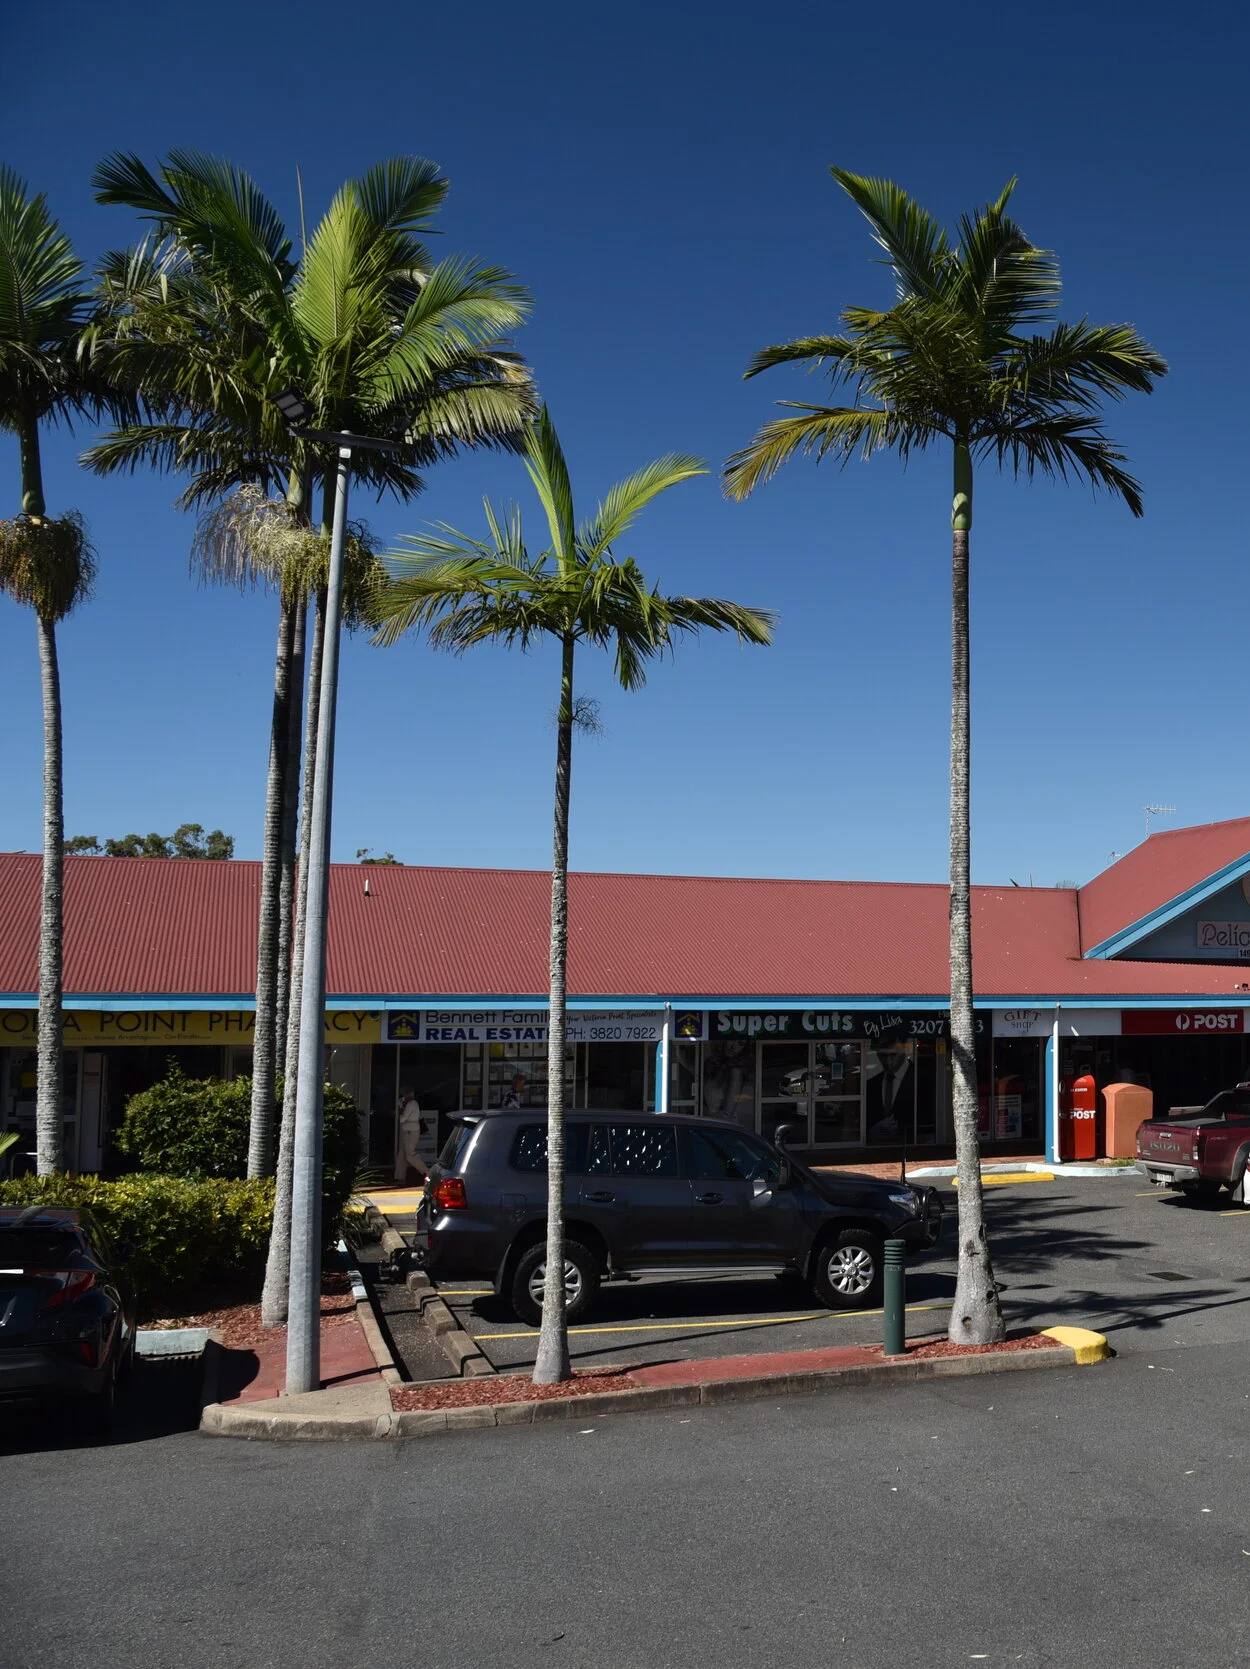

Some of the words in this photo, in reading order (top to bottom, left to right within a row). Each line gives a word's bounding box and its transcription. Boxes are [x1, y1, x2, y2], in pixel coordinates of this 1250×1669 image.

[100, 1011, 193, 1033] POINT
[426, 1010, 497, 1024] Bennett
[503, 1010, 551, 1024] Famil
[717, 1010, 789, 1036] Super
[801, 1010, 853, 1032] Cuts
[1004, 1009, 1042, 1023] GIFT
[1193, 1014, 1239, 1029] POST
[863, 1019, 880, 1038] By
[908, 1020, 945, 1035] 3207
[1010, 1021, 1034, 1030] SHOP
[426, 1027, 479, 1040] REAL
[486, 1027, 551, 1040] ESTAT
[565, 1027, 586, 1039] PH:
[590, 1027, 622, 1040] 3820
[625, 1027, 656, 1039] 7922
[1070, 1109, 1096, 1120] POST
